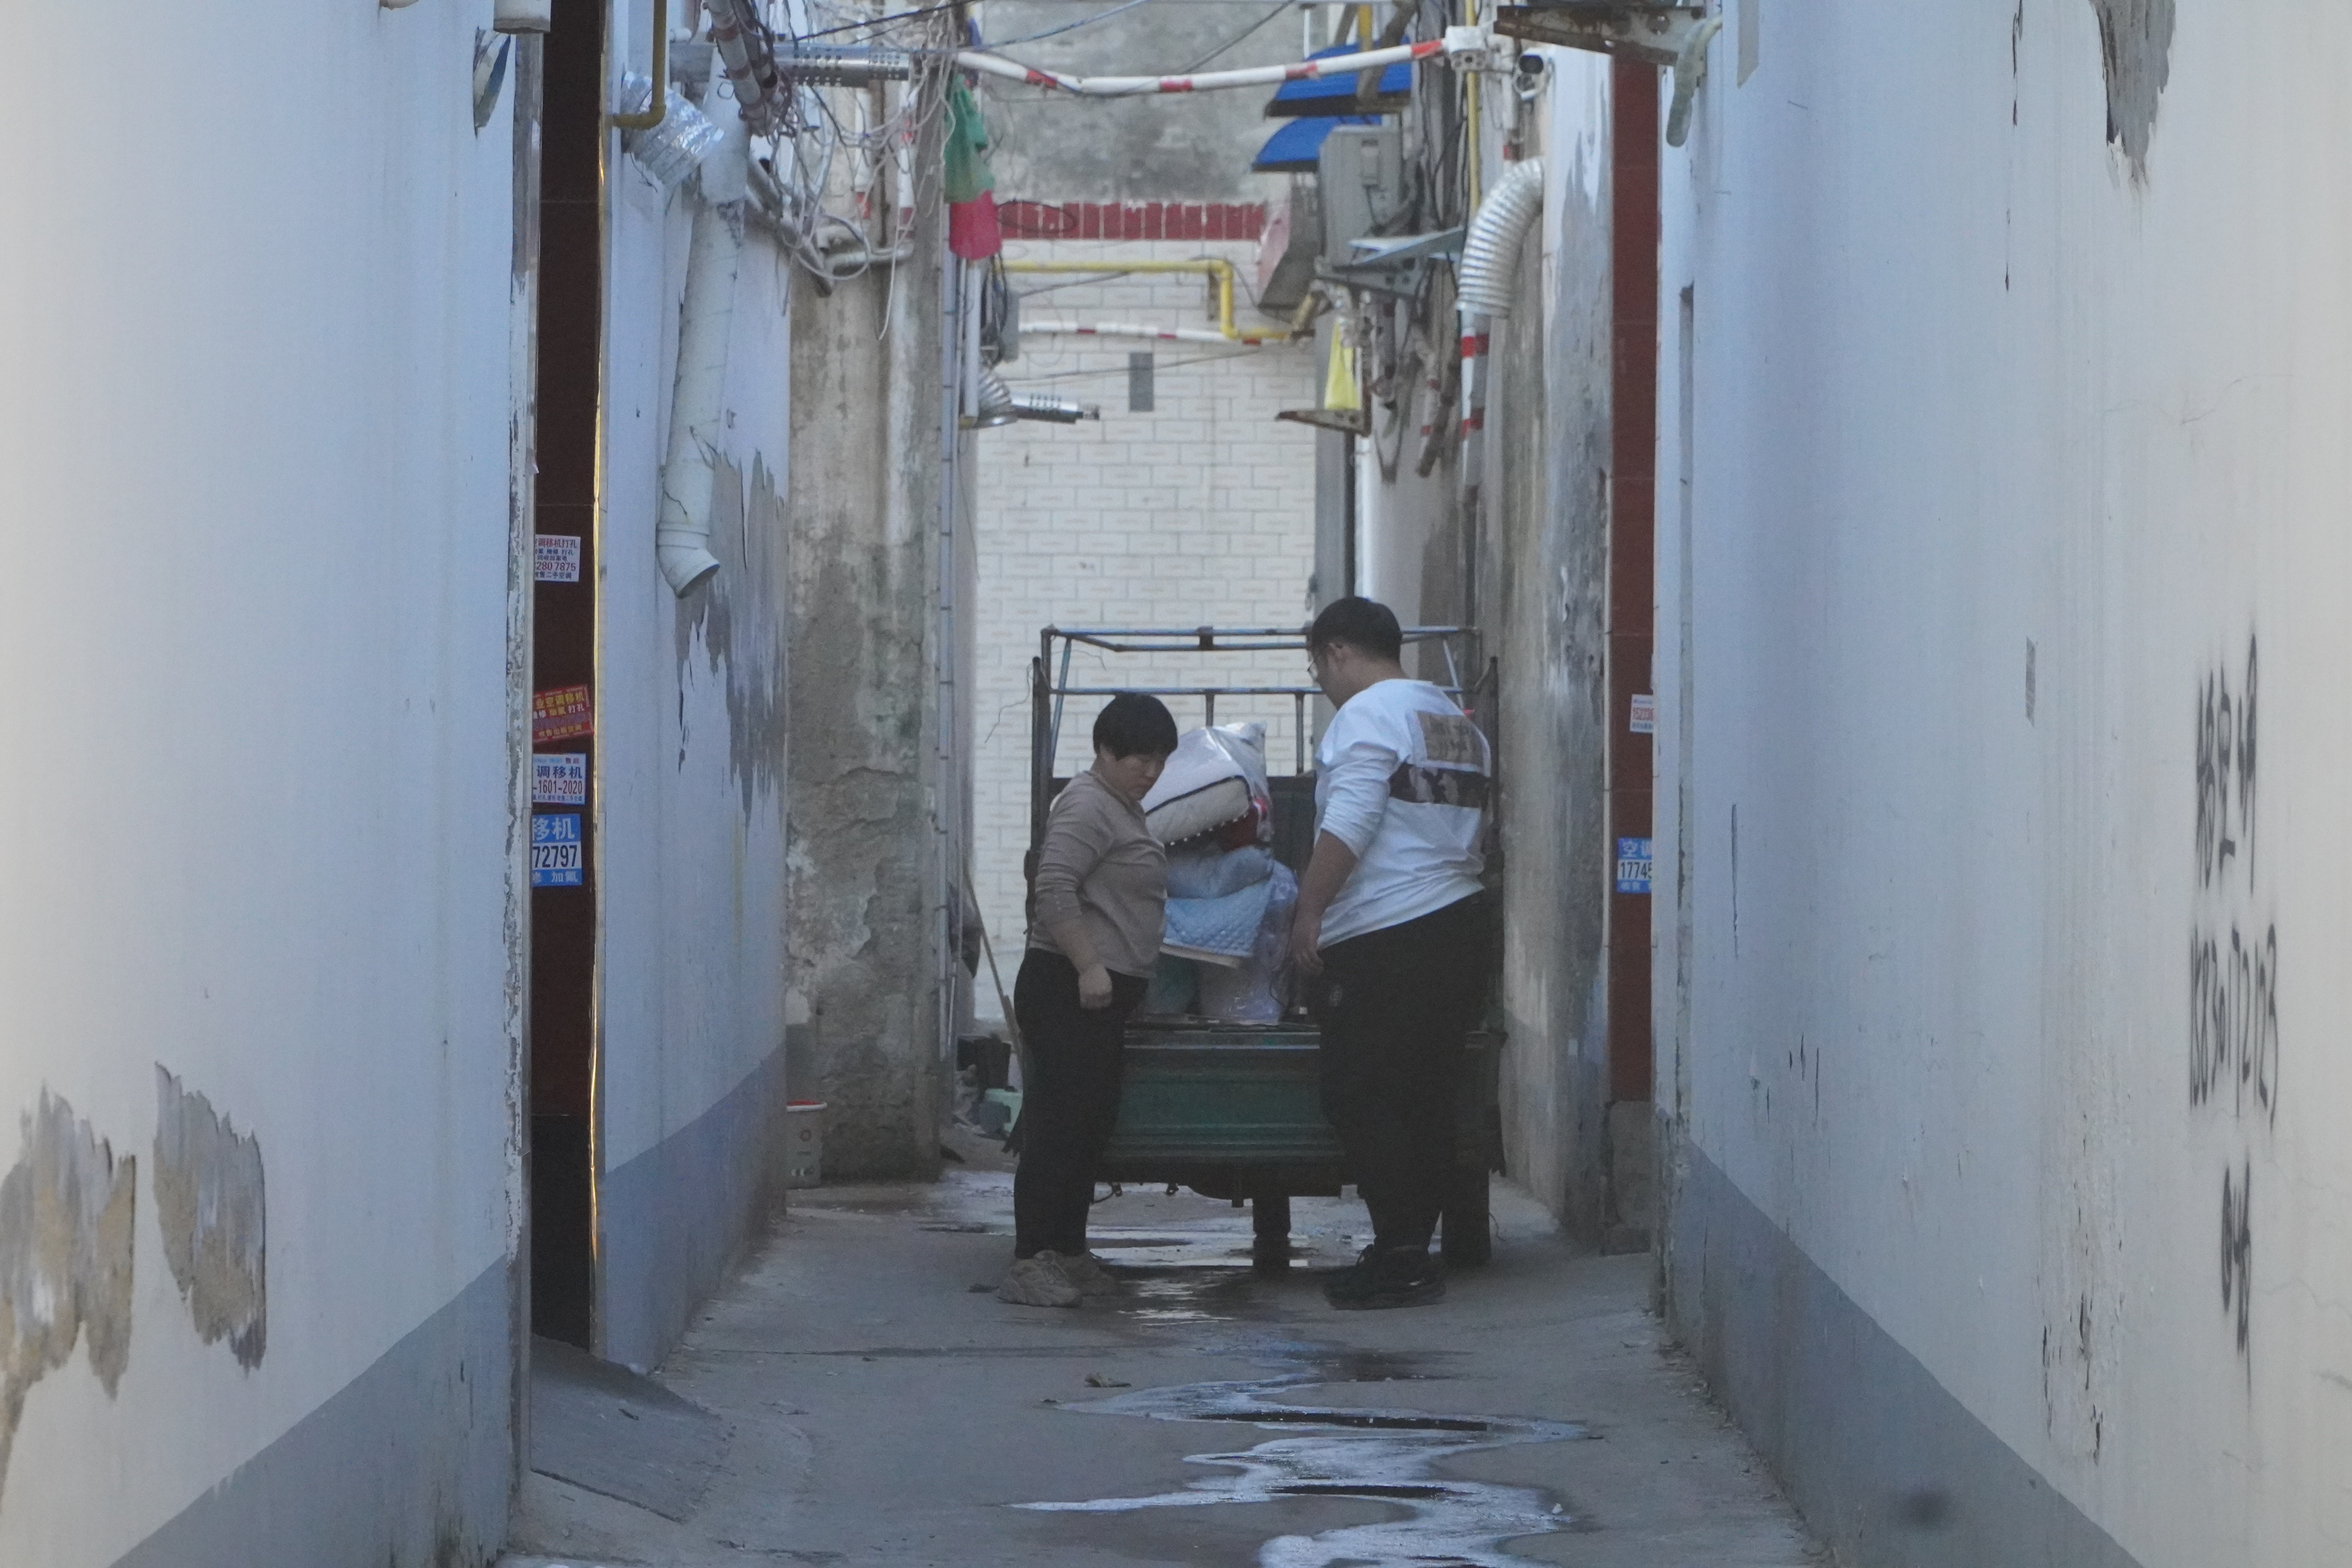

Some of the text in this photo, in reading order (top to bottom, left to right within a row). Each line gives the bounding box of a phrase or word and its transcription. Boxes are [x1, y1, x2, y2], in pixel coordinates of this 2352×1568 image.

[536, 766, 583, 779] 调移机
[532, 816, 575, 841] 移机
[532, 845, 577, 868] 72797
